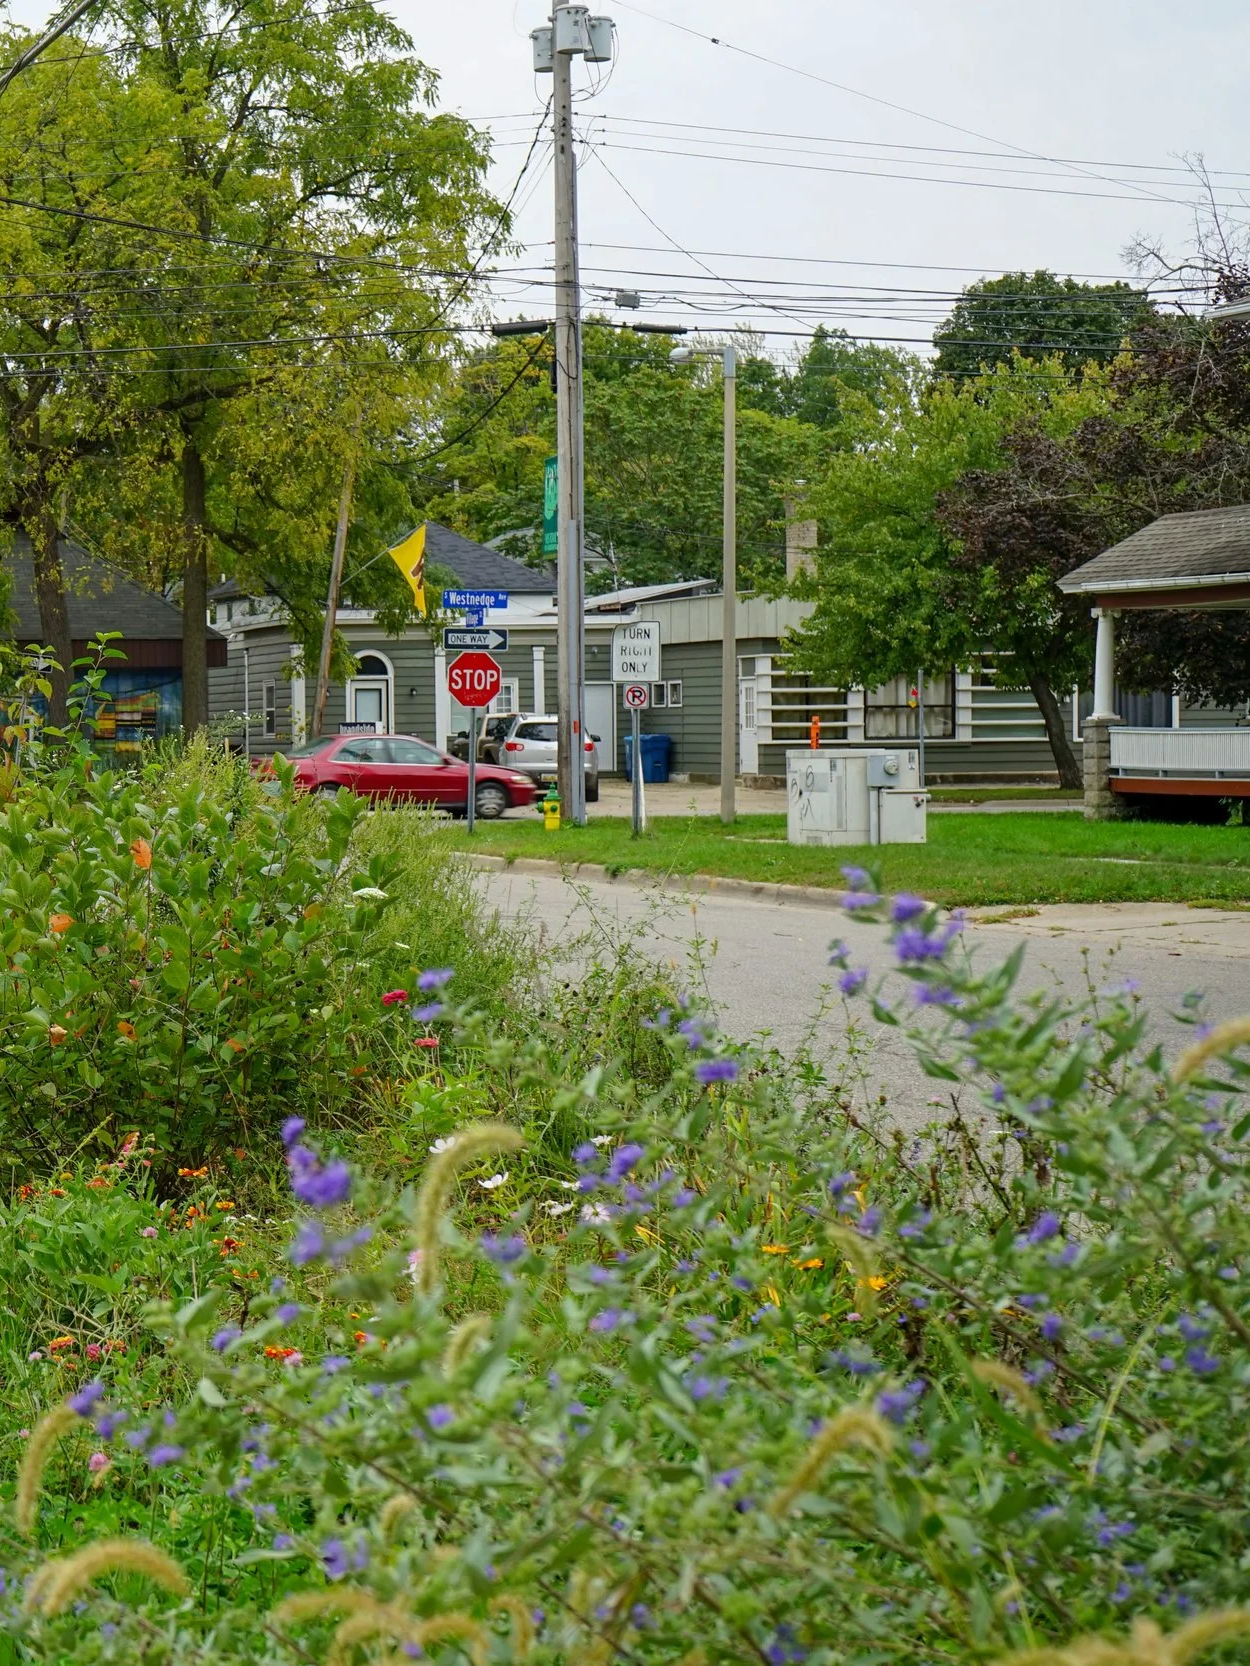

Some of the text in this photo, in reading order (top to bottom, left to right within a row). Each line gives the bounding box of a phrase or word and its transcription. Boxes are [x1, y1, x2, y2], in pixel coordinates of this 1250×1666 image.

[449, 591, 495, 608] Westnedge
[498, 593, 507, 601] Ave
[450, 634, 488, 644] ONE WAY
[622, 628, 650, 640] TURN
[621, 661, 648, 673] ONLY
[451, 668, 498, 690] STOP
